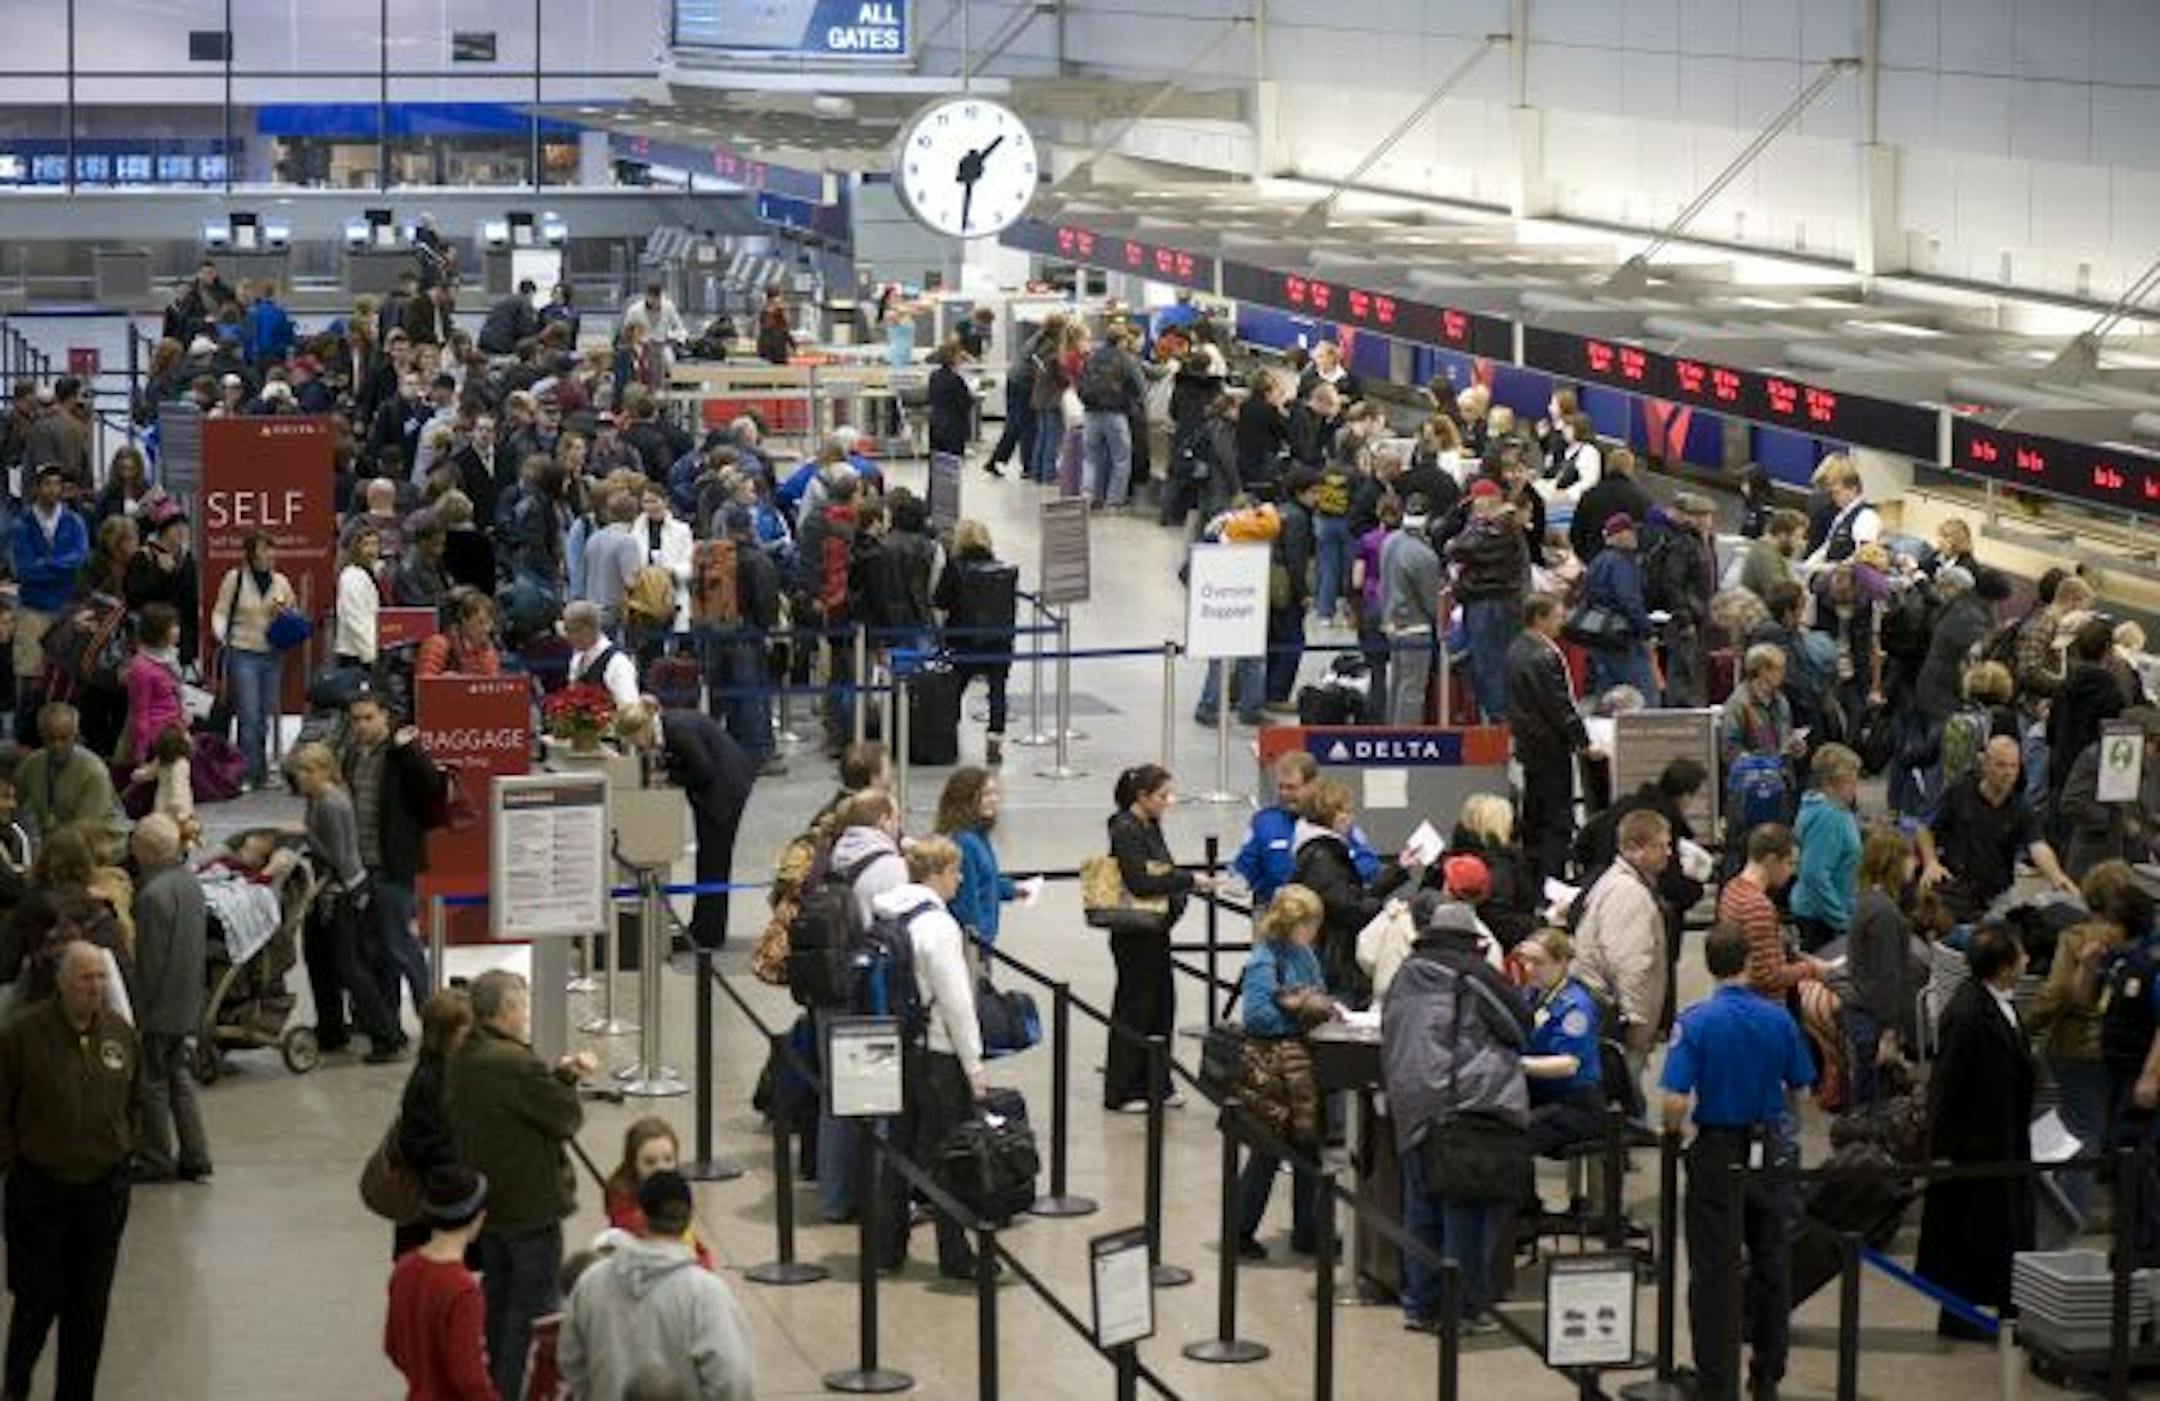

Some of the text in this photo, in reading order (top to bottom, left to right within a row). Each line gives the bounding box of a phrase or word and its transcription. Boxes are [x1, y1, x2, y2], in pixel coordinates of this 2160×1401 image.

[859, 3, 898, 23] ALL
[828, 26, 899, 49] GATES
[207, 491, 304, 528] SELF
[420, 728, 525, 751] BAGGAGE
[1355, 741, 1439, 758] DELTA
